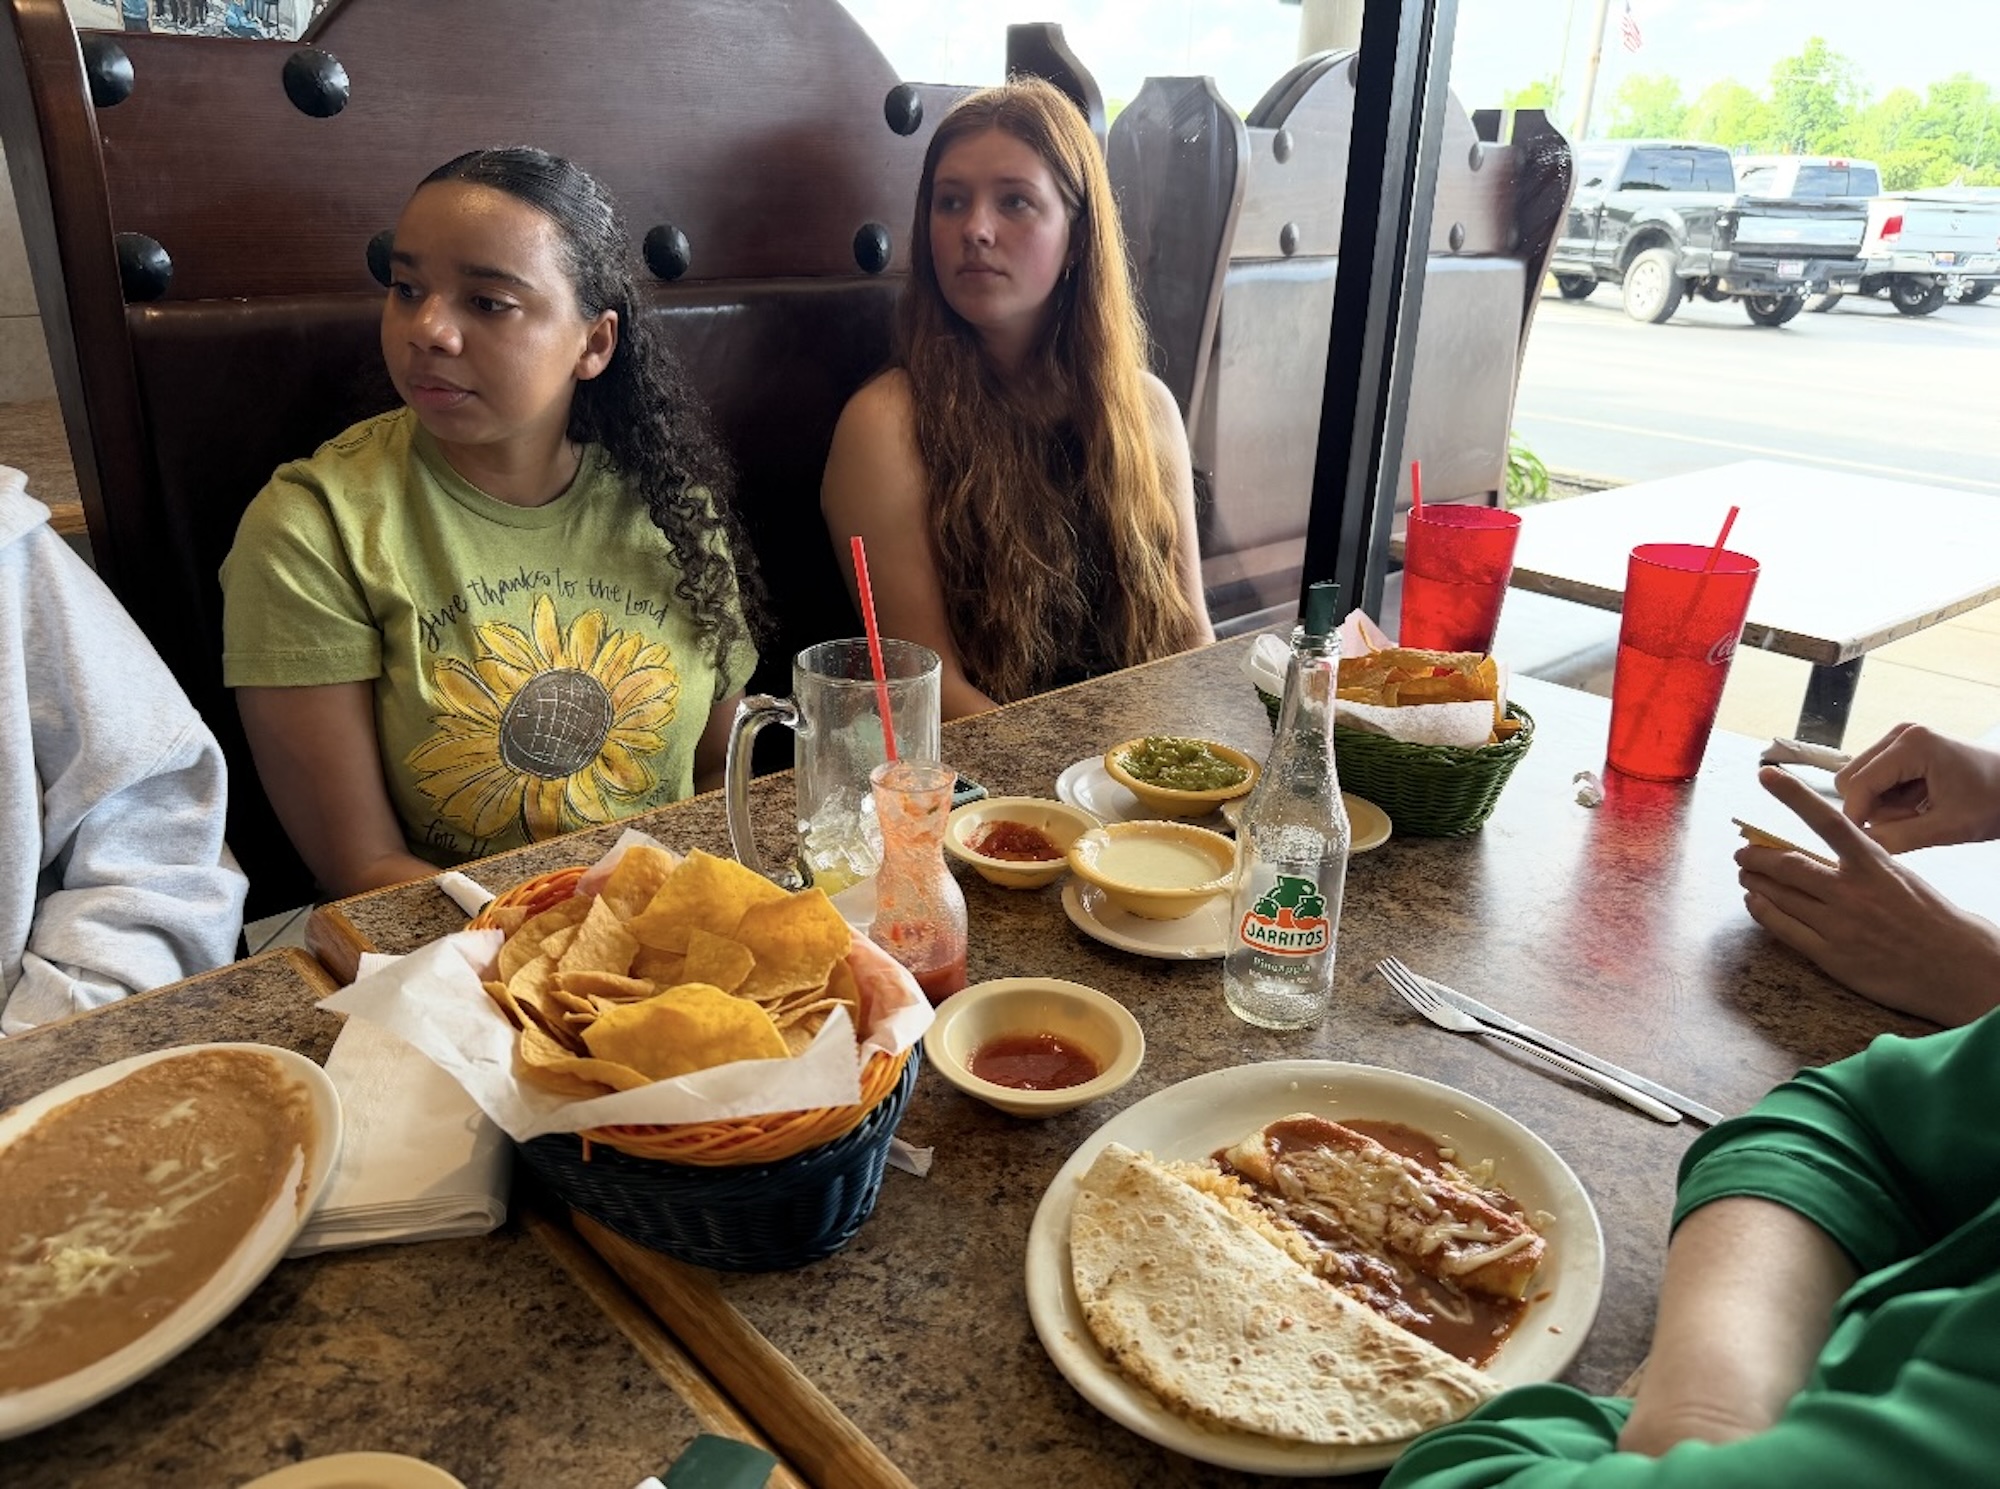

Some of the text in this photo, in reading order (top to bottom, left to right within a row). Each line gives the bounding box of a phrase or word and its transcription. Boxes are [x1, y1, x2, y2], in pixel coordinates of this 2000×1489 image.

[419, 566, 670, 653] give thanks to the Lord
[423, 818, 458, 849] for
[1246, 922, 1323, 947] JARRITOS
